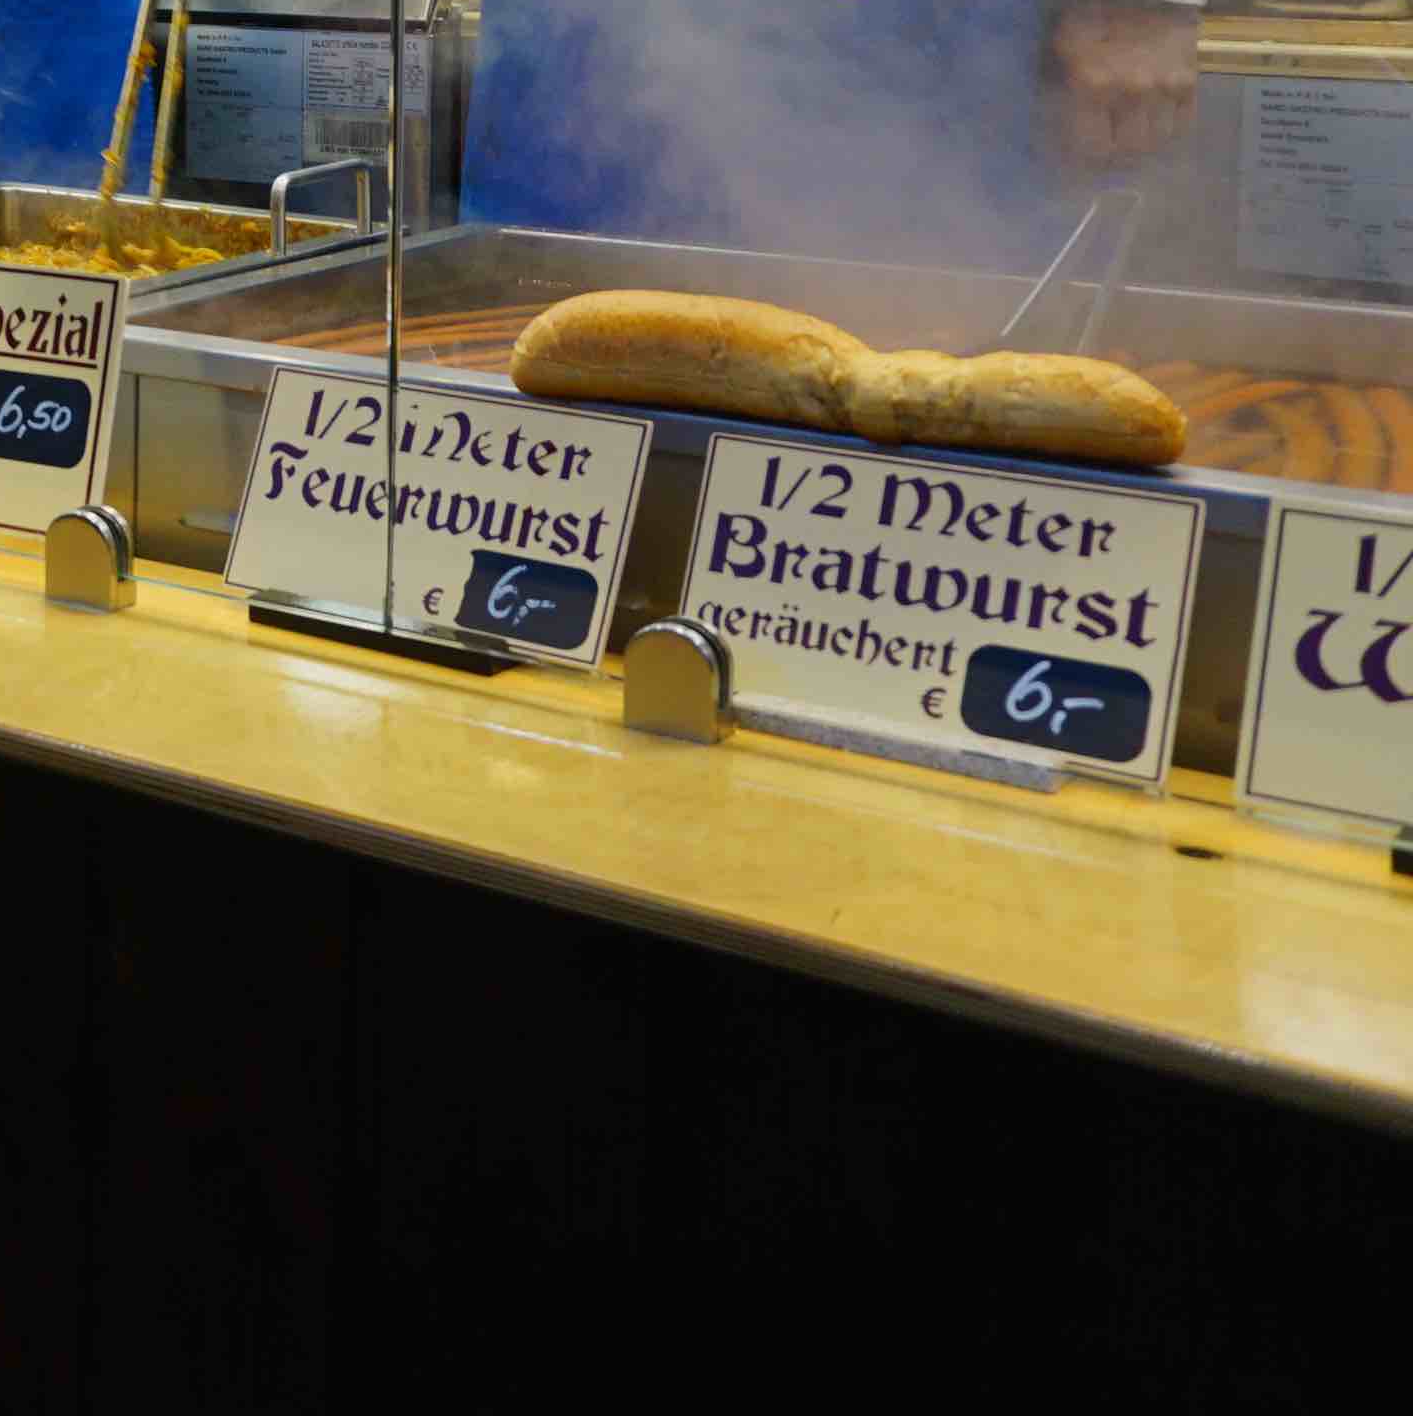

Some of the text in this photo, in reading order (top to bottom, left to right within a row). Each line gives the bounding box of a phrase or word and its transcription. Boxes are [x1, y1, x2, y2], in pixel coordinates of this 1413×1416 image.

[304, 389, 592, 480] 1/2 Meter
[264, 440, 611, 563] Feuerwurst
[760, 456, 1116, 558] 1/2 Meter
[422, 586, 444, 616] €
[709, 511, 1160, 648] Bratwurst
[697, 600, 959, 677] geräuchert
[920, 687, 948, 719] €
